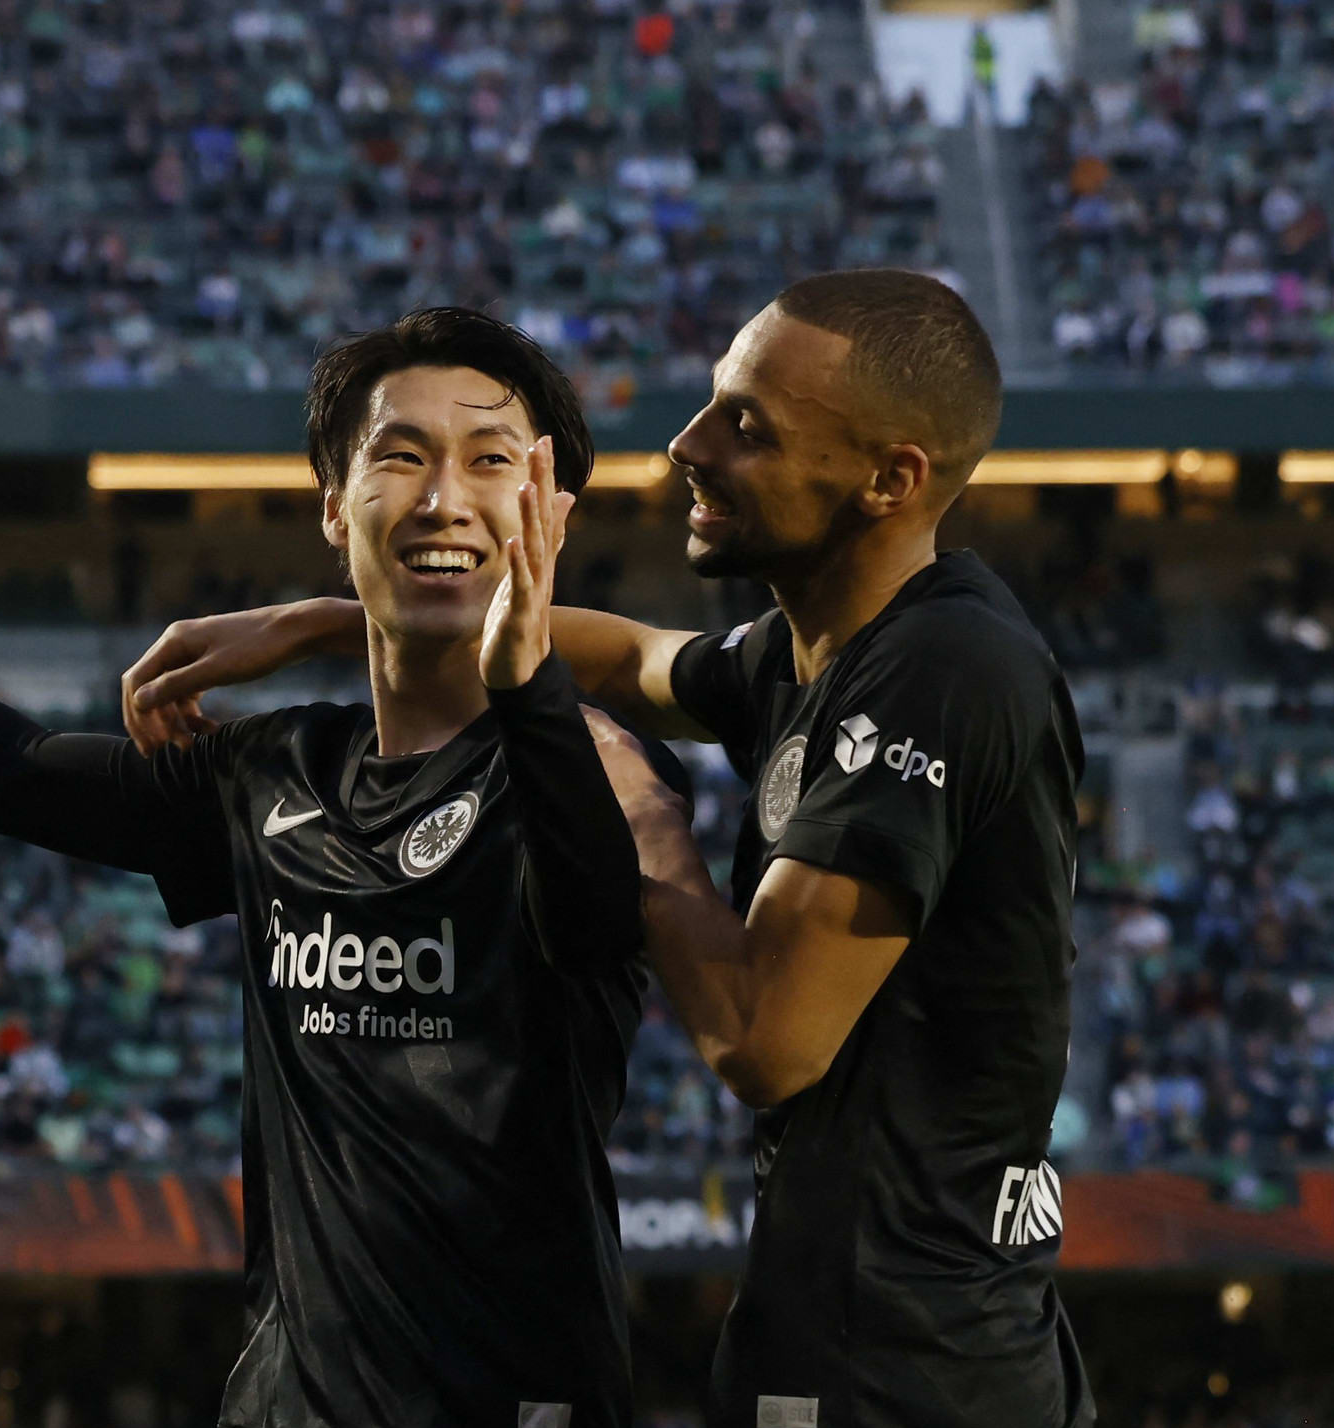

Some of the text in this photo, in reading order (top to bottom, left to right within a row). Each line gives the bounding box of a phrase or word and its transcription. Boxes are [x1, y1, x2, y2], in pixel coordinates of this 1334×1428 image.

[265, 898, 455, 995] indeed
[299, 1002, 453, 1039] Jobs finden
